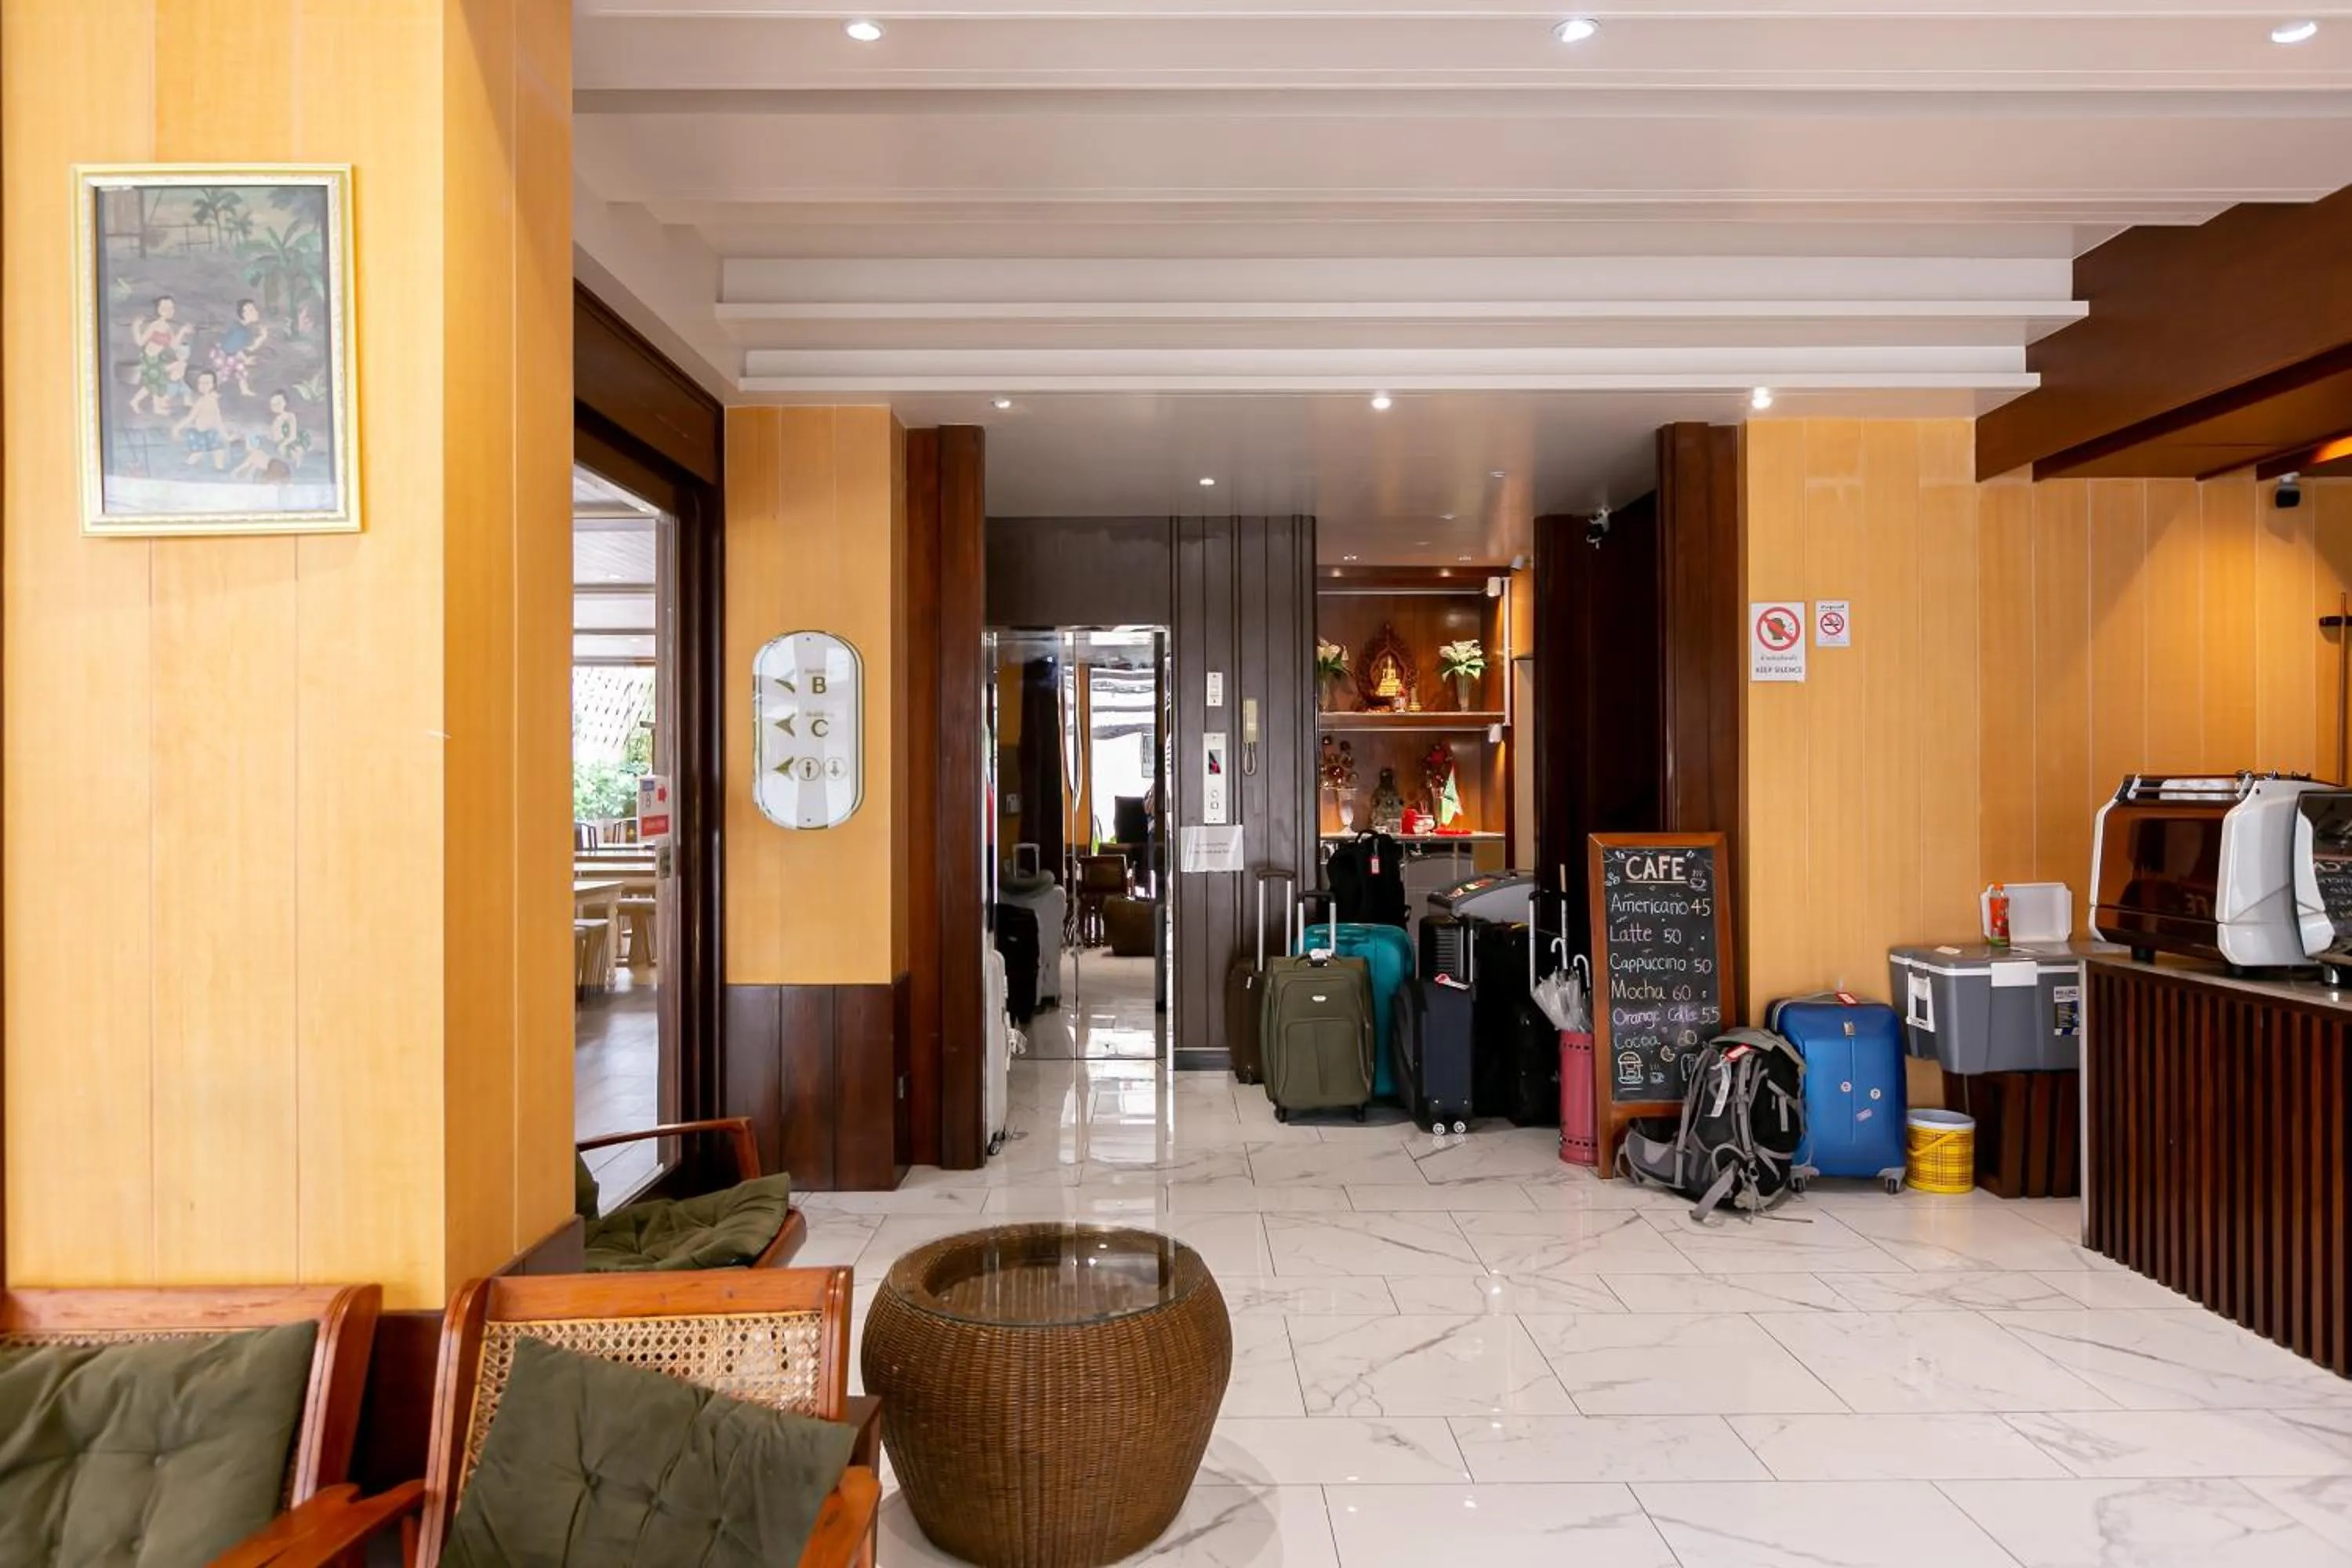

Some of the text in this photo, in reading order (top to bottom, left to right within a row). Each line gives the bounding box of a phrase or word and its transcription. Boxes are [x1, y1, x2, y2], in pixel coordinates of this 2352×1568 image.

[812, 677, 826, 694] B
[811, 719, 829, 738] C
[1625, 855, 1686, 880] CAFE
[1610, 892, 1711, 916] Americano 45
[1610, 922, 1682, 945] Latte 50
[1610, 953, 1712, 975] Cappuccino 50
[1611, 978, 1691, 1001] Mocha 60
[1613, 1007, 1661, 1029] Orange
[1700, 1007, 1720, 1024] 55
[1614, 1033, 1661, 1049] Cocoa
